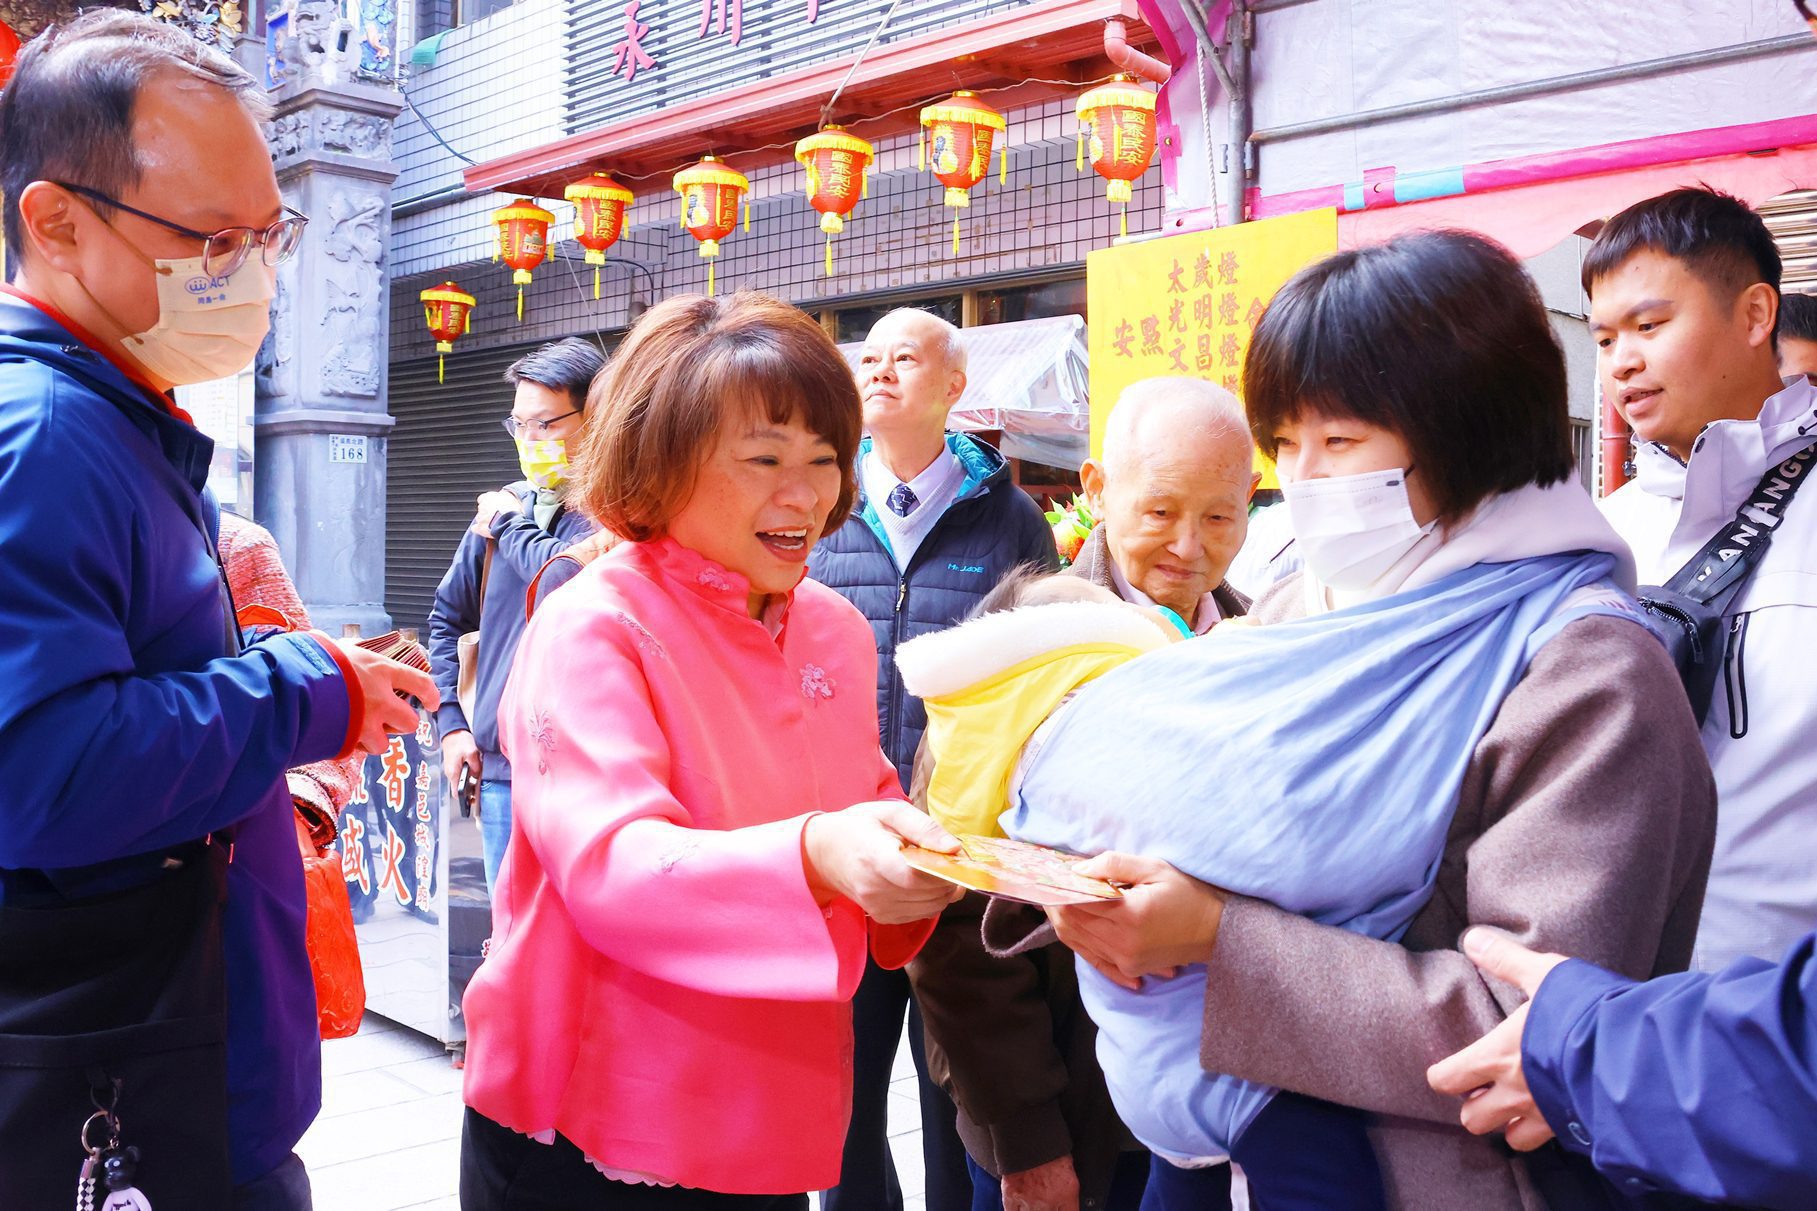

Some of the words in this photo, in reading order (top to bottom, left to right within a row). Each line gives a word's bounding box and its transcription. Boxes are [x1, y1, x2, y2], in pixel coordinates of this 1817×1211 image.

[1119, 109, 1147, 166] 國泰民安
[826, 150, 853, 199] 國泰民安
[210, 276, 230, 288] ACT
[1167, 251, 1240, 294] 太歲燈
[1168, 292, 1240, 333] 光明燈
[1168, 332, 1241, 372] 文昌燈
[341, 447, 363, 460] 168
[379, 737, 411, 903] 香火
